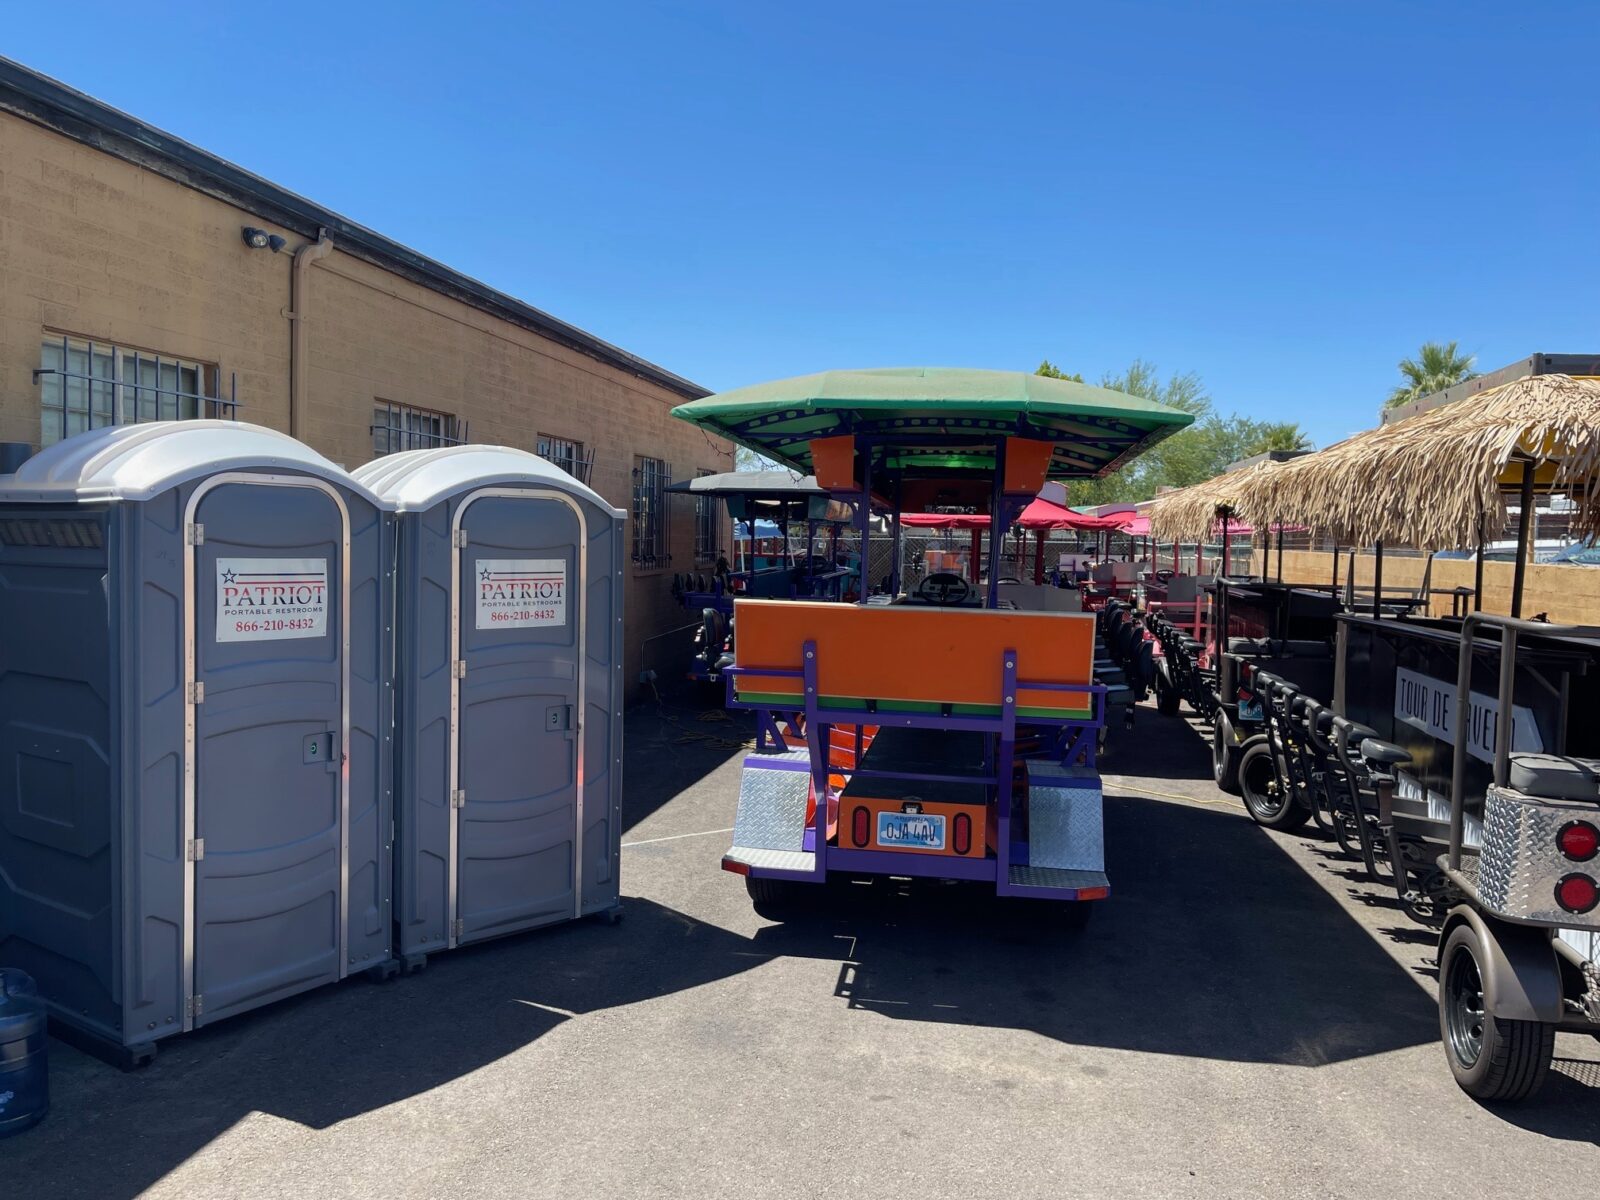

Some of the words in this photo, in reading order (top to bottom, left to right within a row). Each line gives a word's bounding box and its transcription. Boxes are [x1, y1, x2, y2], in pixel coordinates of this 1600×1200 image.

[223, 585, 326, 607] PATRIOT
[480, 582, 564, 600] PATRIOT
[224, 608, 272, 616] PORTABLE
[276, 606, 323, 614] RESTROOMS
[491, 610, 555, 622] 866-210-8432
[235, 618, 314, 632] 866-210-8432
[1401, 678, 1428, 722] TOUR
[1433, 689, 1450, 732] DE
